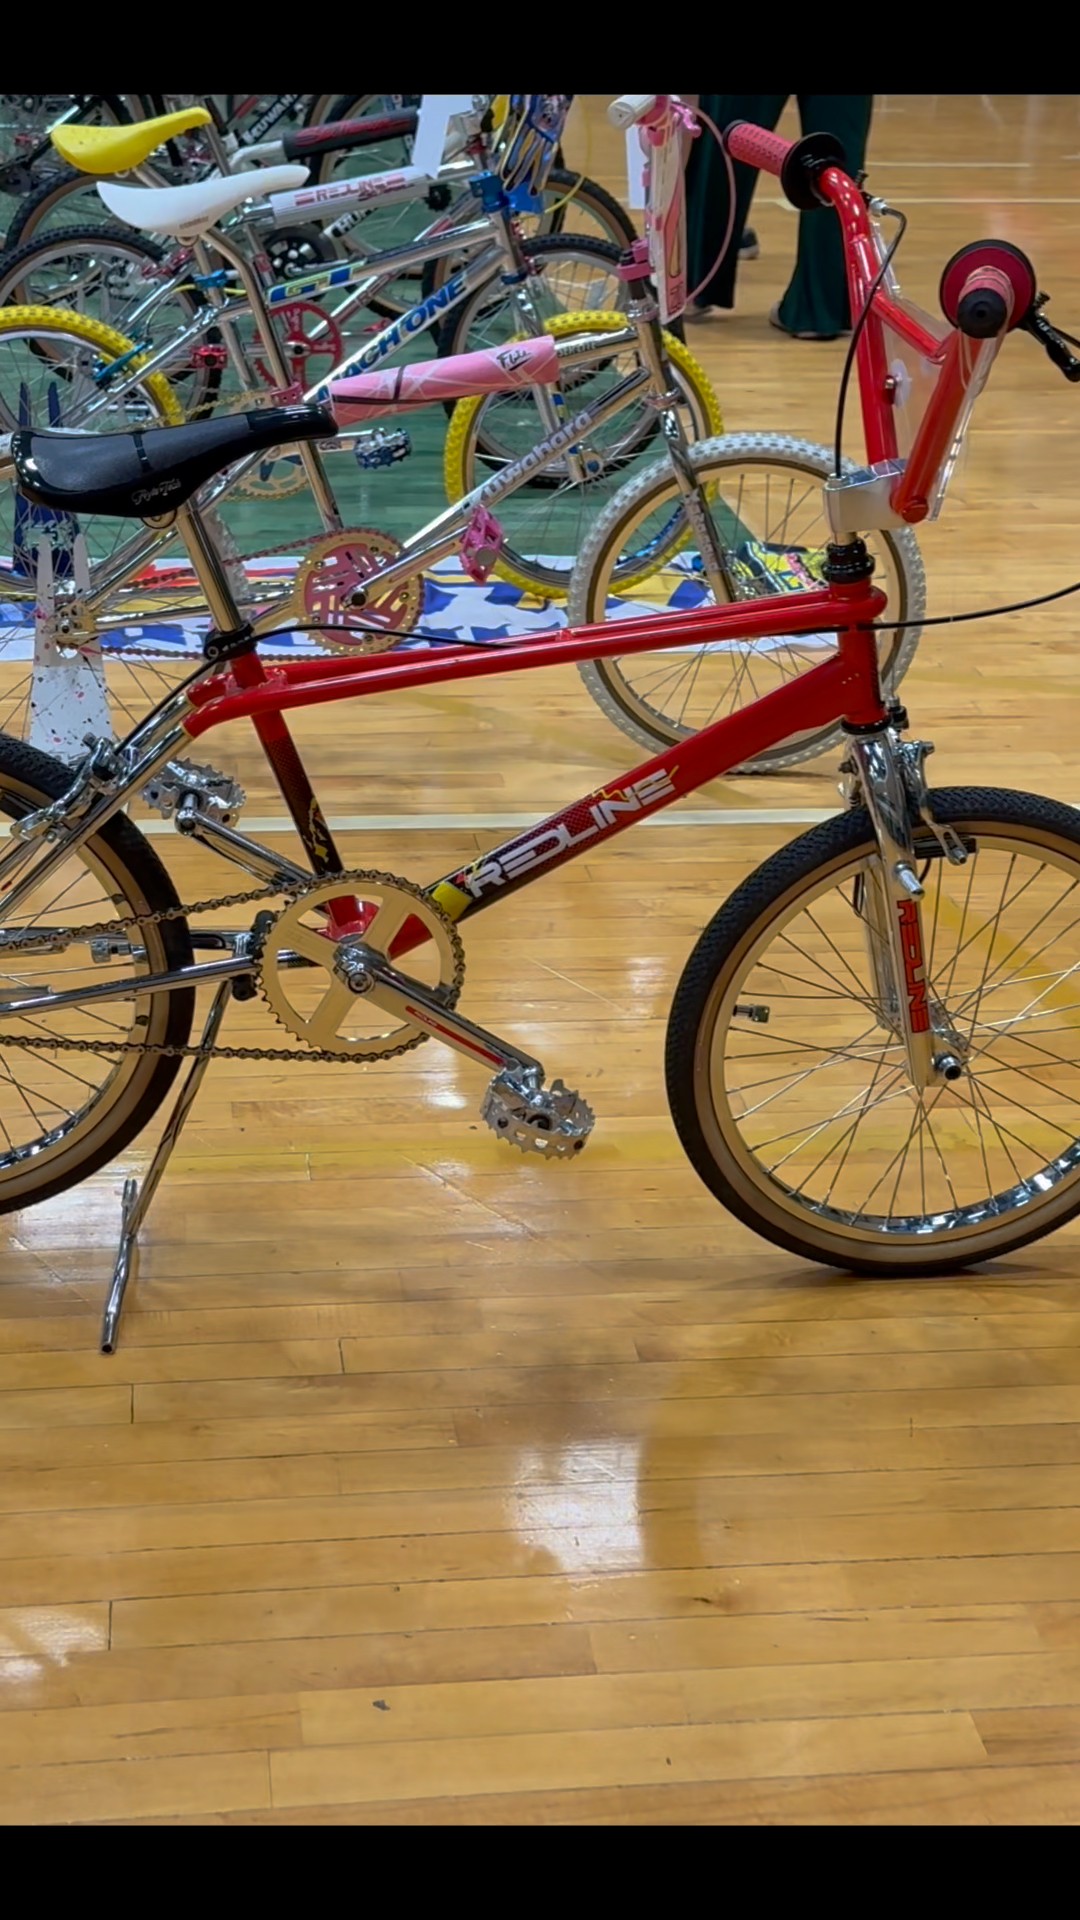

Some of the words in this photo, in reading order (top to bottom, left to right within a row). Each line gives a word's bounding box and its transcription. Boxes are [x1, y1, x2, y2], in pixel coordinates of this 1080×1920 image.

[404, 272, 468, 333] ONE
[467, 768, 676, 898] REDLINE
[897, 899, 931, 1034] REDLINE
